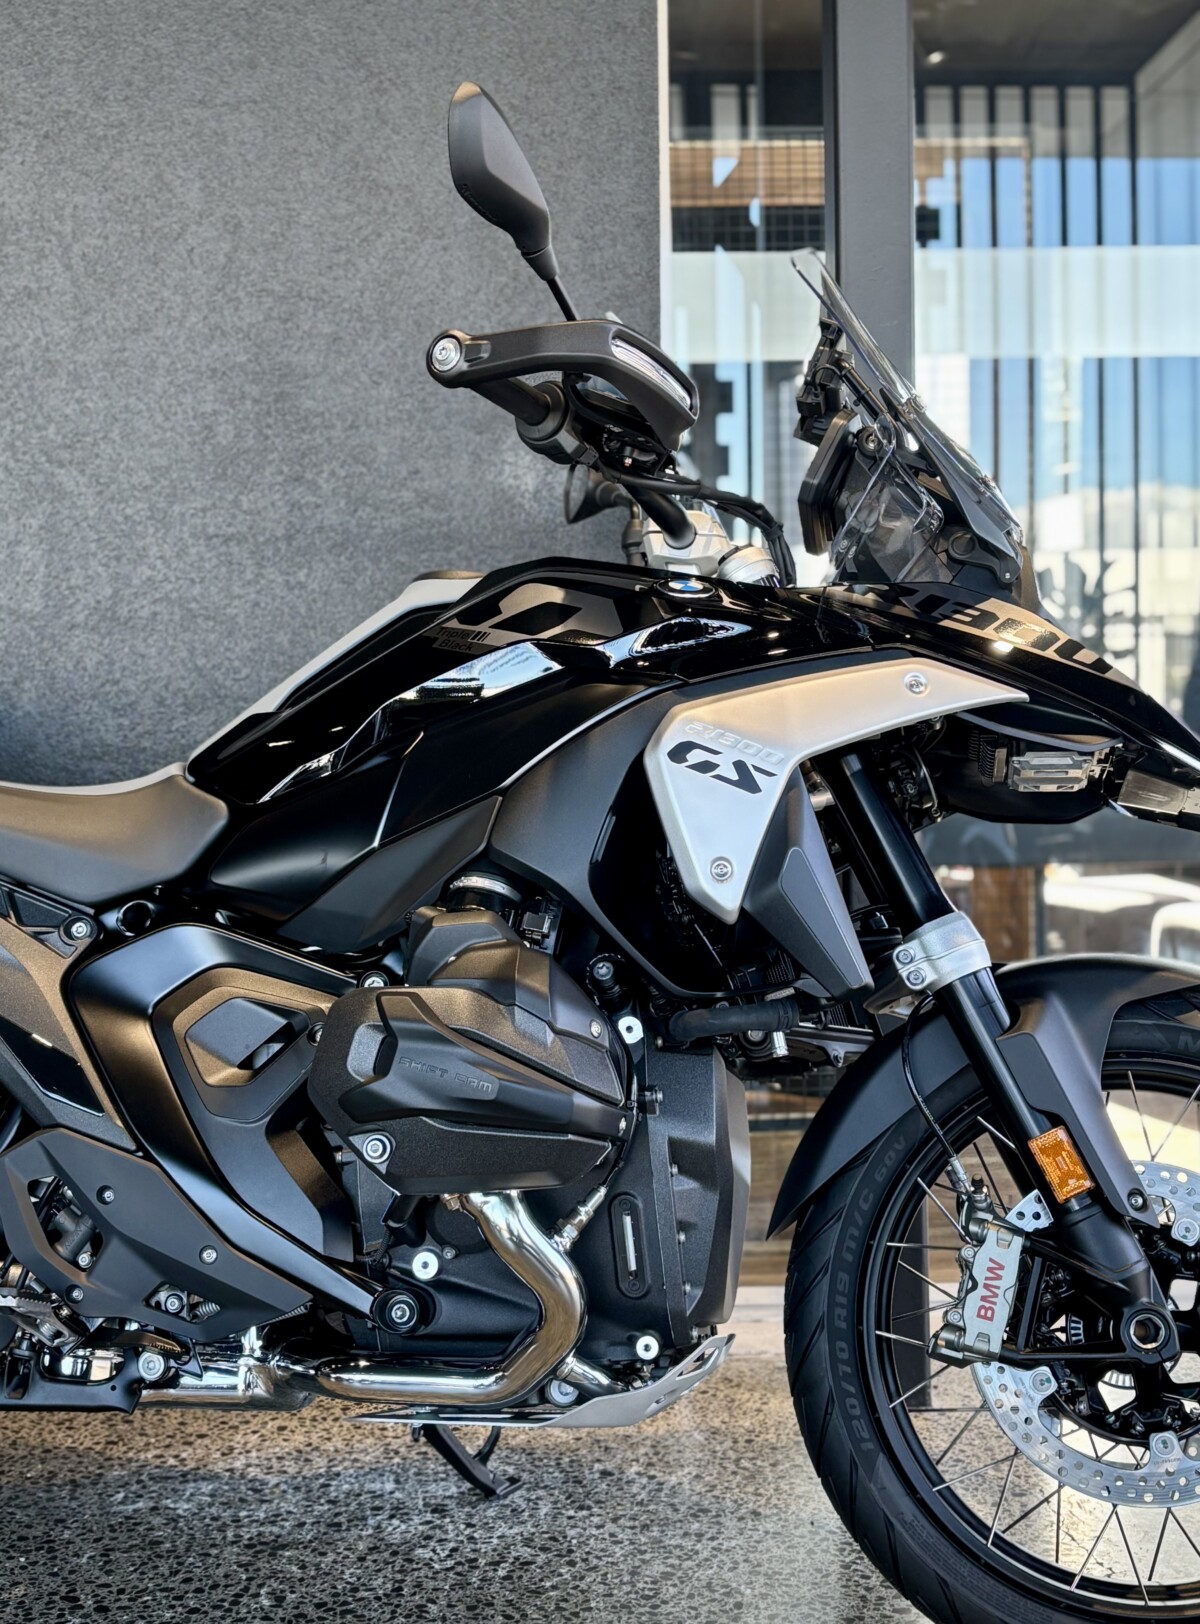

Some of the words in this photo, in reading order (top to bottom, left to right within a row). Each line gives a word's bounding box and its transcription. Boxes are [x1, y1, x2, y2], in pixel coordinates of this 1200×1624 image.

[435, 628, 470, 640] Triple
[438, 639, 474, 652] Black
[667, 740, 778, 795] GS
[399, 1056, 449, 1078] SHIFT
[455, 1072, 492, 1093] CAM
[874, 1135, 907, 1183] 60V
[834, 1271, 850, 1329] R19
[976, 1257, 1005, 1322] BMW
[835, 1345, 875, 1451] 120/70
